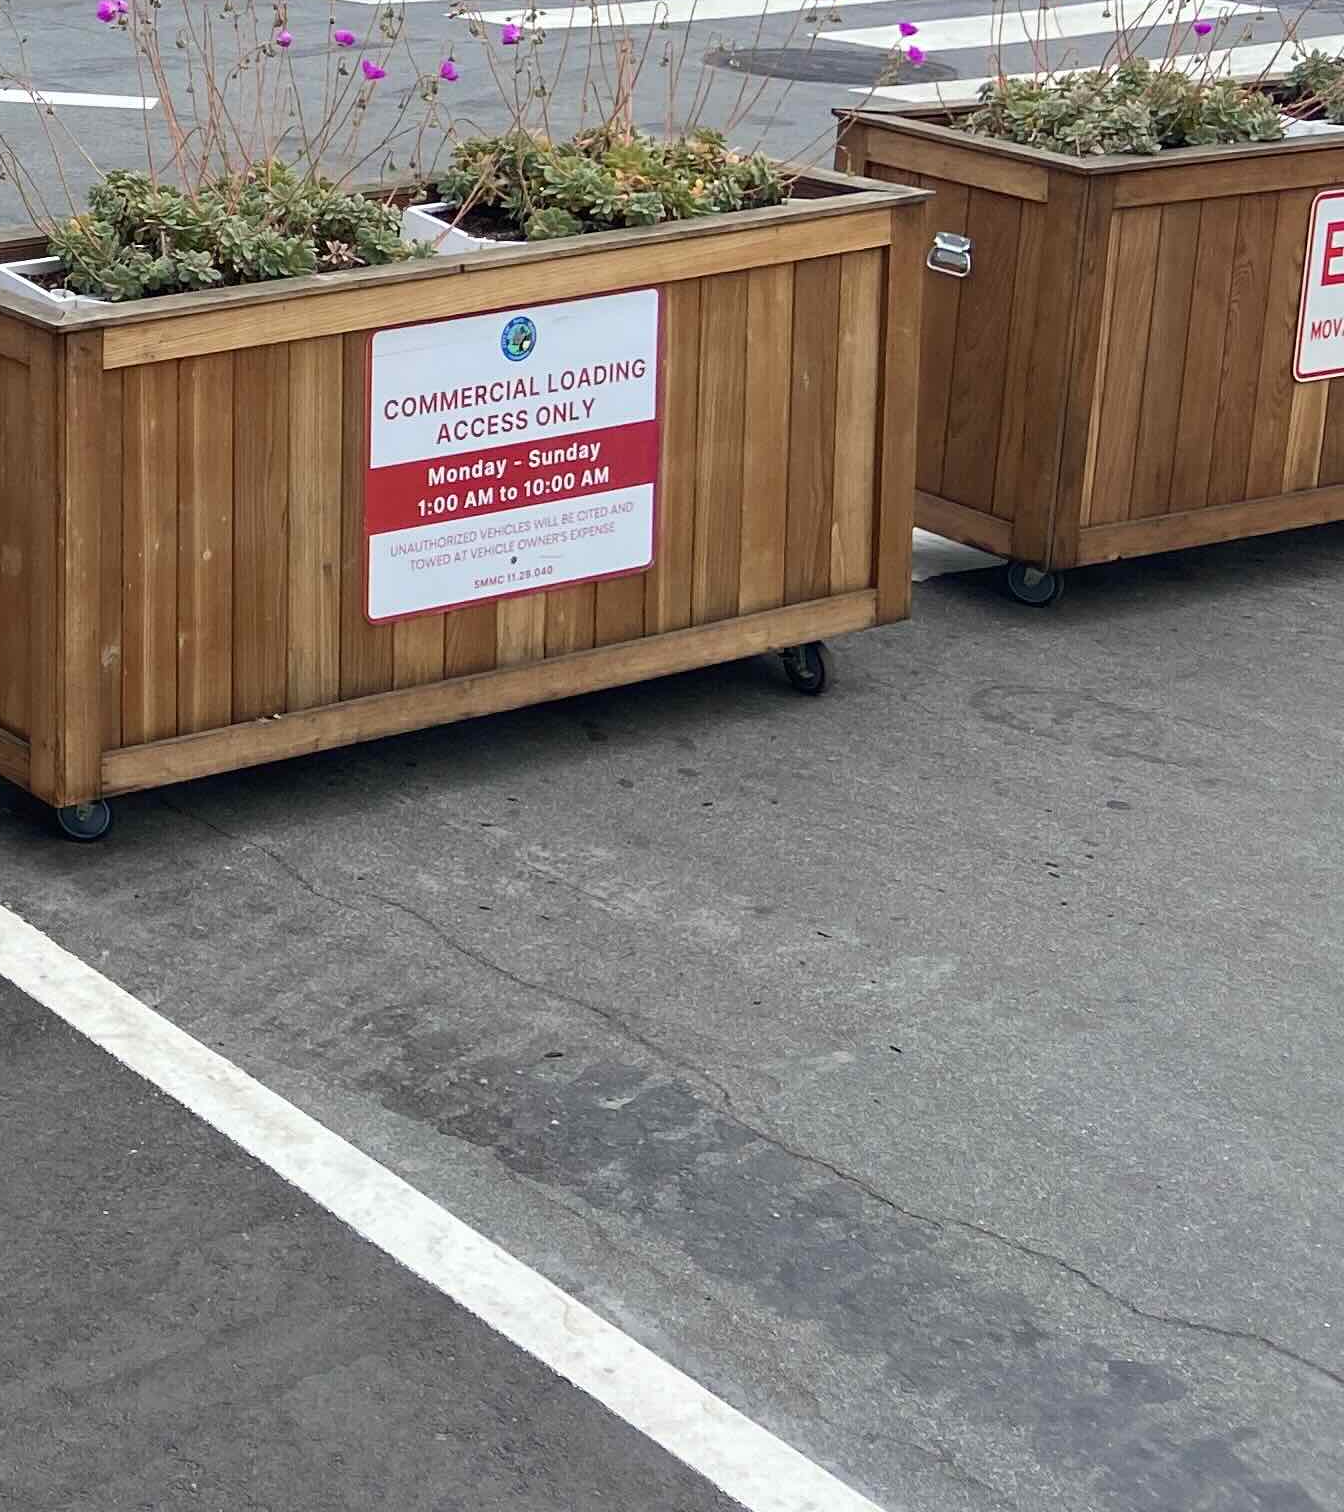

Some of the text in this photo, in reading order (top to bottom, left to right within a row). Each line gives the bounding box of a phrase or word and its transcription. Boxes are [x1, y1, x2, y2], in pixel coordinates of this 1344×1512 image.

[1311, 319, 1344, 341] MOV
[384, 358, 646, 420] COMMERCIAL LOADING
[436, 397, 595, 445] ACCESS ONLY
[427, 458, 507, 486] Monday
[528, 441, 601, 468] Sunday
[417, 466, 610, 517] 1:00 AM to 10:00 AM
[390, 502, 634, 558] UNAUTHORIZED VEHICLES WILL BE CITED AND
[410, 522, 615, 572] TOWED AT VEHICLE OWNER'S EXPENSE
[474, 575, 505, 589] SMMC
